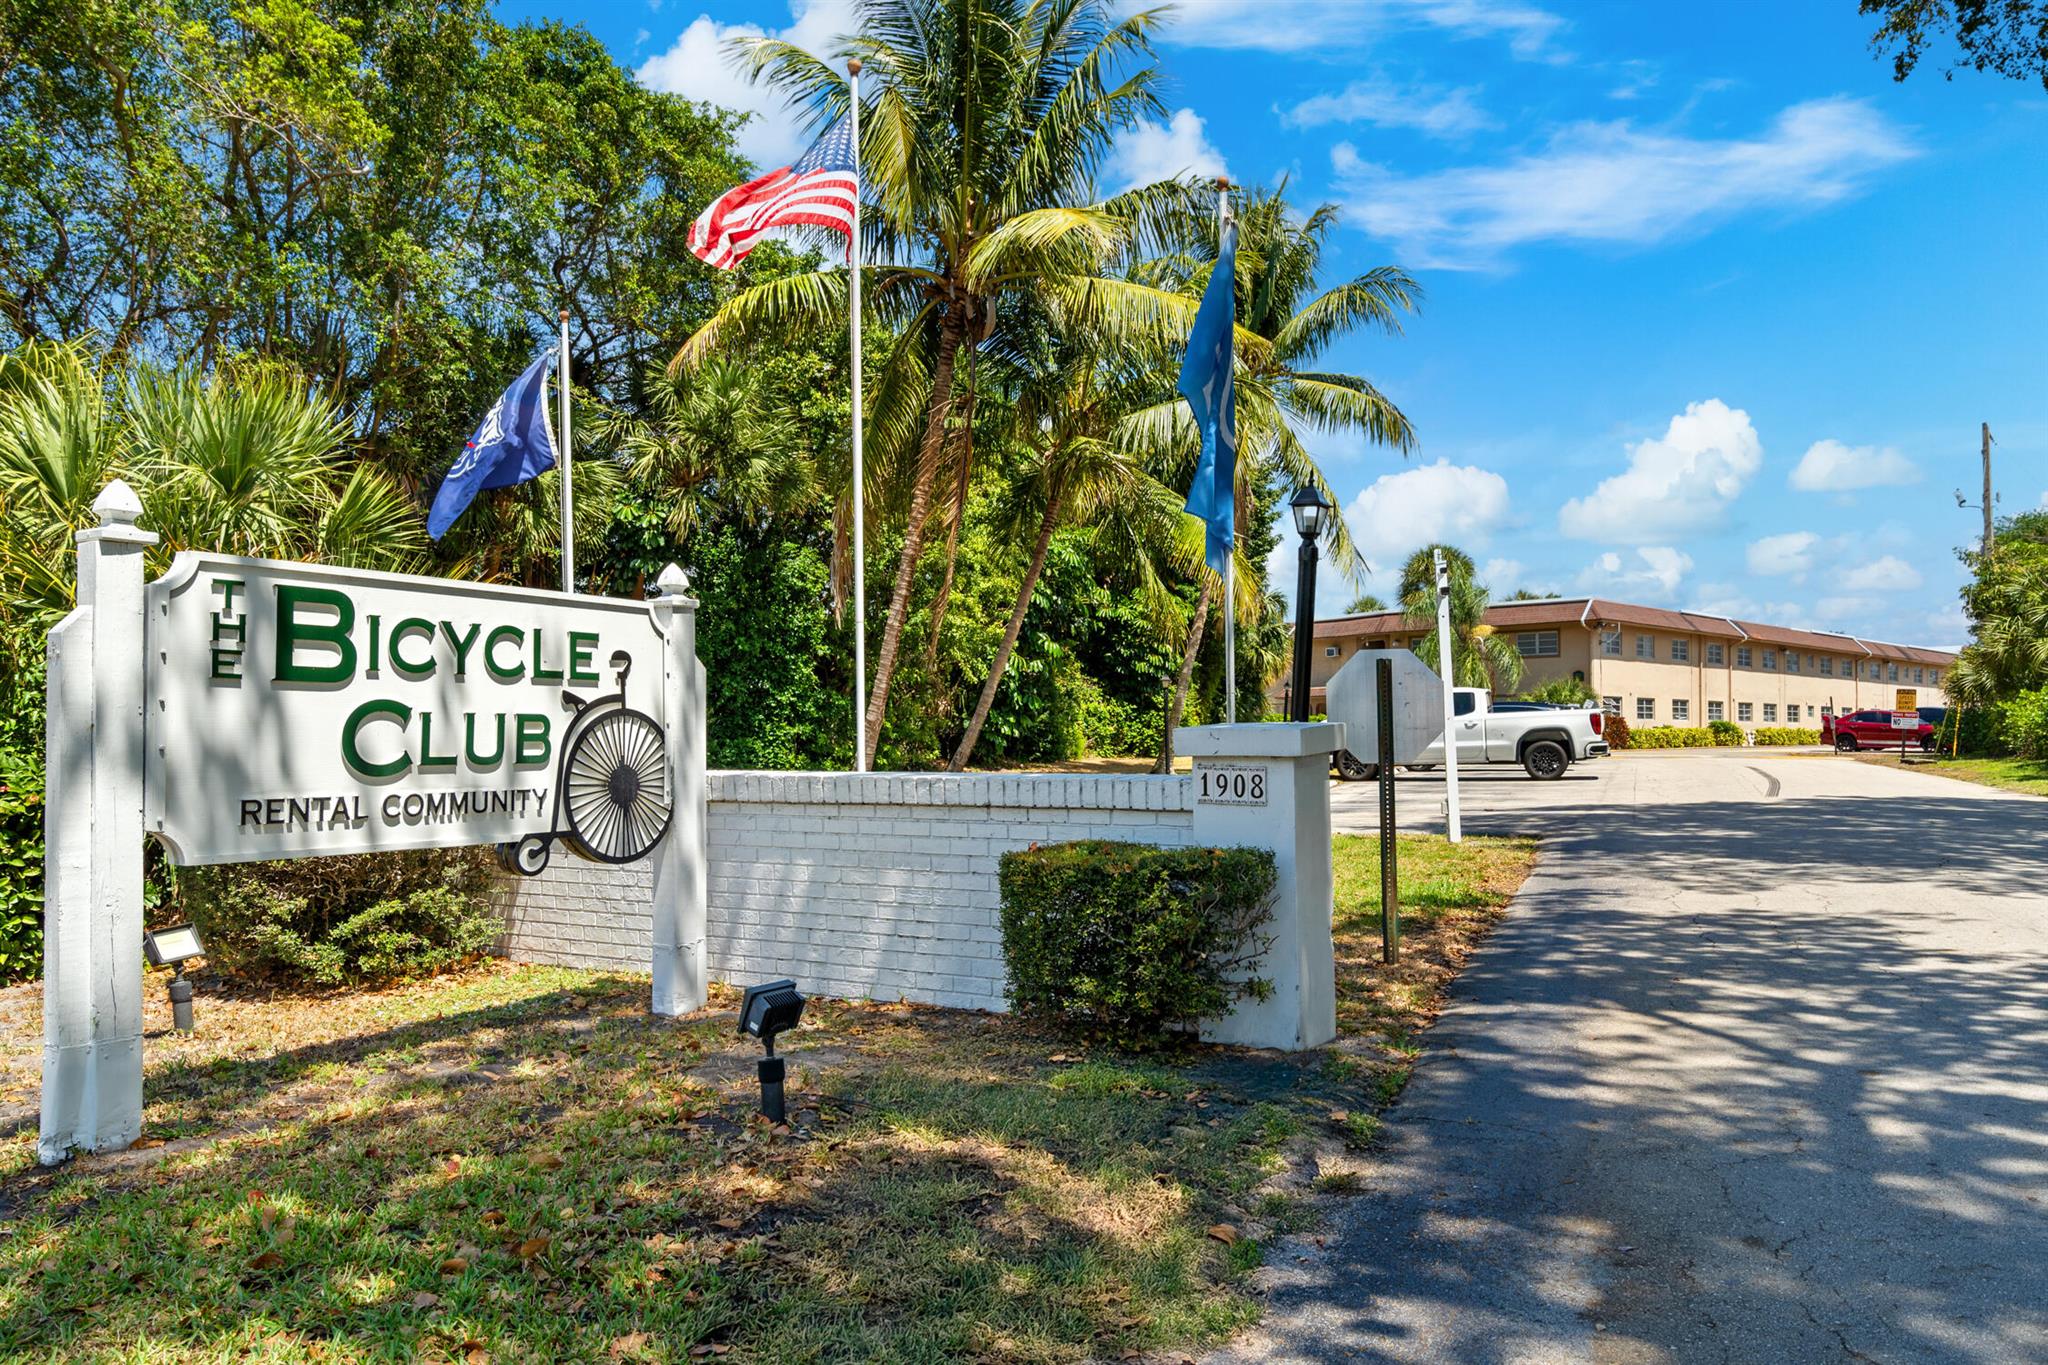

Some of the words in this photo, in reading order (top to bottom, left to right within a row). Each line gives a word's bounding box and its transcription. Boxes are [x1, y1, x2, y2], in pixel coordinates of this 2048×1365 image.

[210, 578, 247, 679] THE
[271, 584, 600, 683] BICYCLE
[341, 699, 552, 778] CLUB
[240, 796, 369, 827] RENTAL
[382, 788, 549, 818] COMMUNITY
[1200, 772, 1264, 799] 1908
